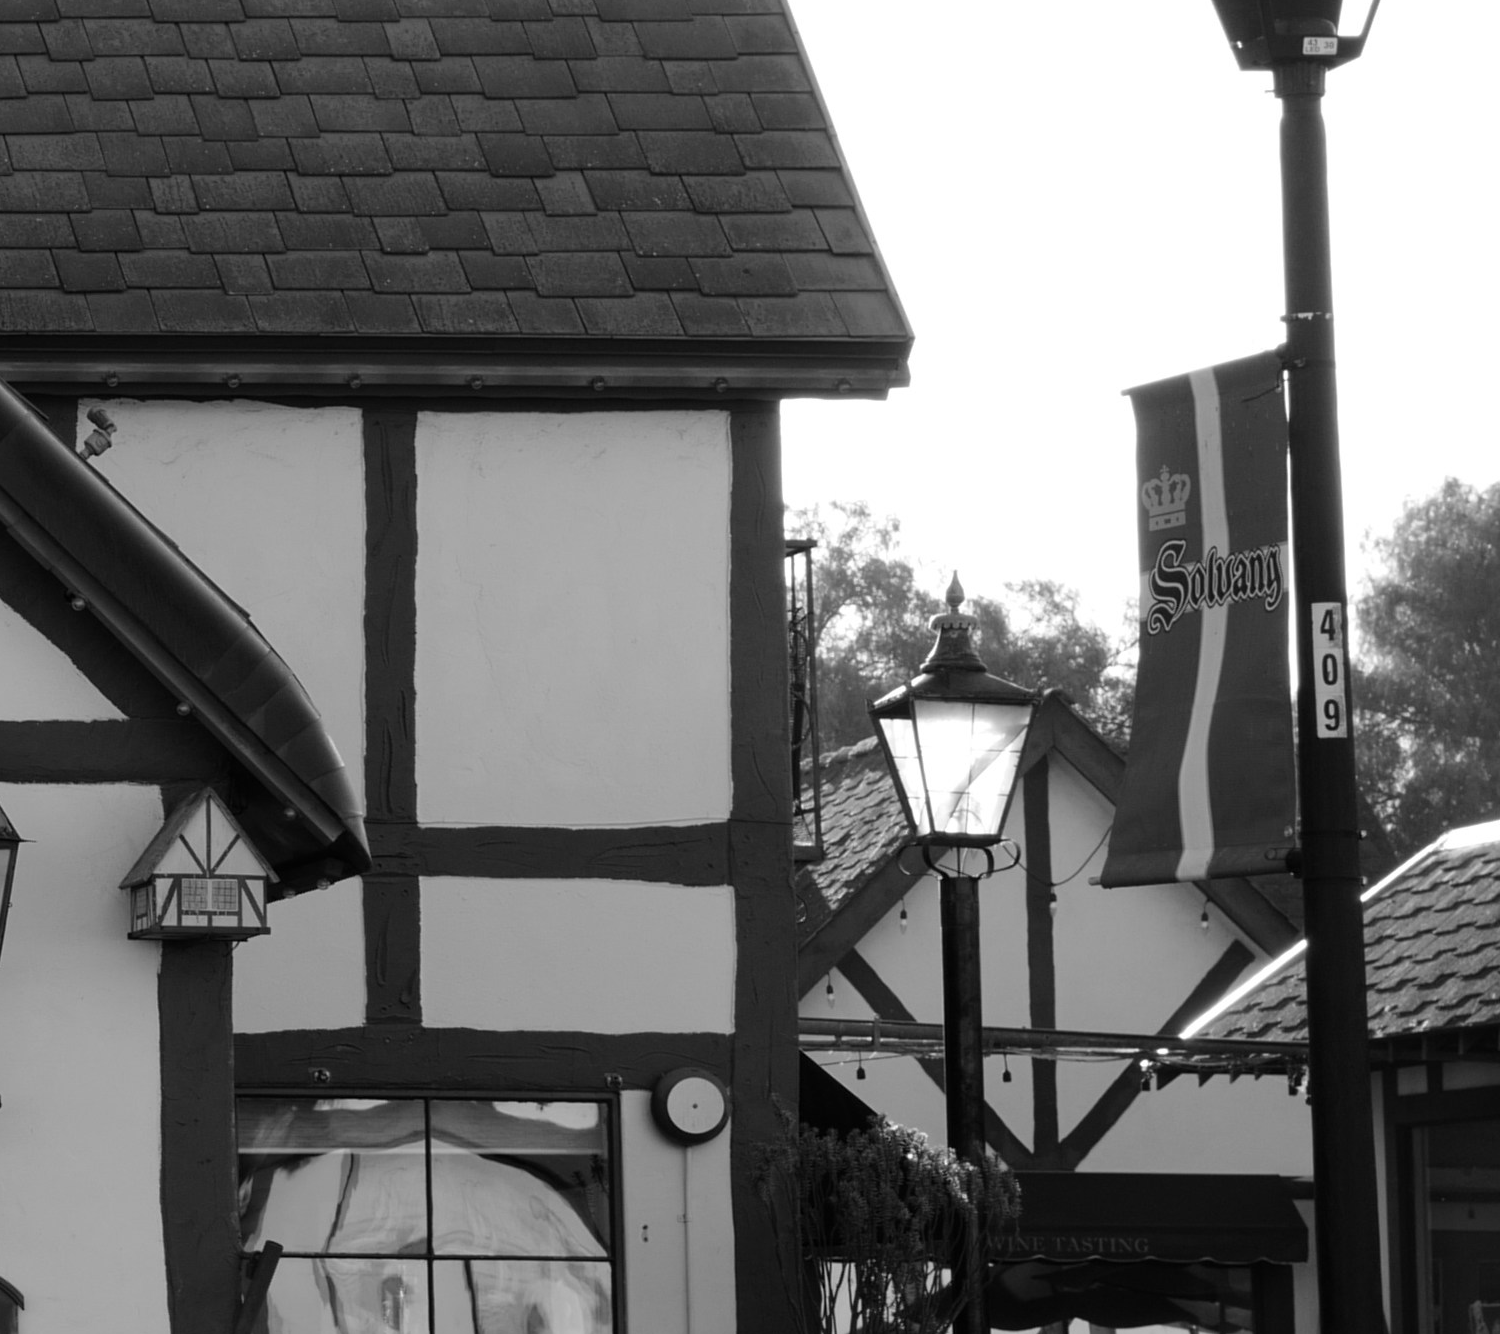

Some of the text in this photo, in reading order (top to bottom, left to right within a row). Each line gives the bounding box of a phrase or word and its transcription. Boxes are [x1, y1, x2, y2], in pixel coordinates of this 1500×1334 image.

[1148, 540, 1284, 634] Solvang
[987, 1235, 1150, 1254] WINE TASTING
